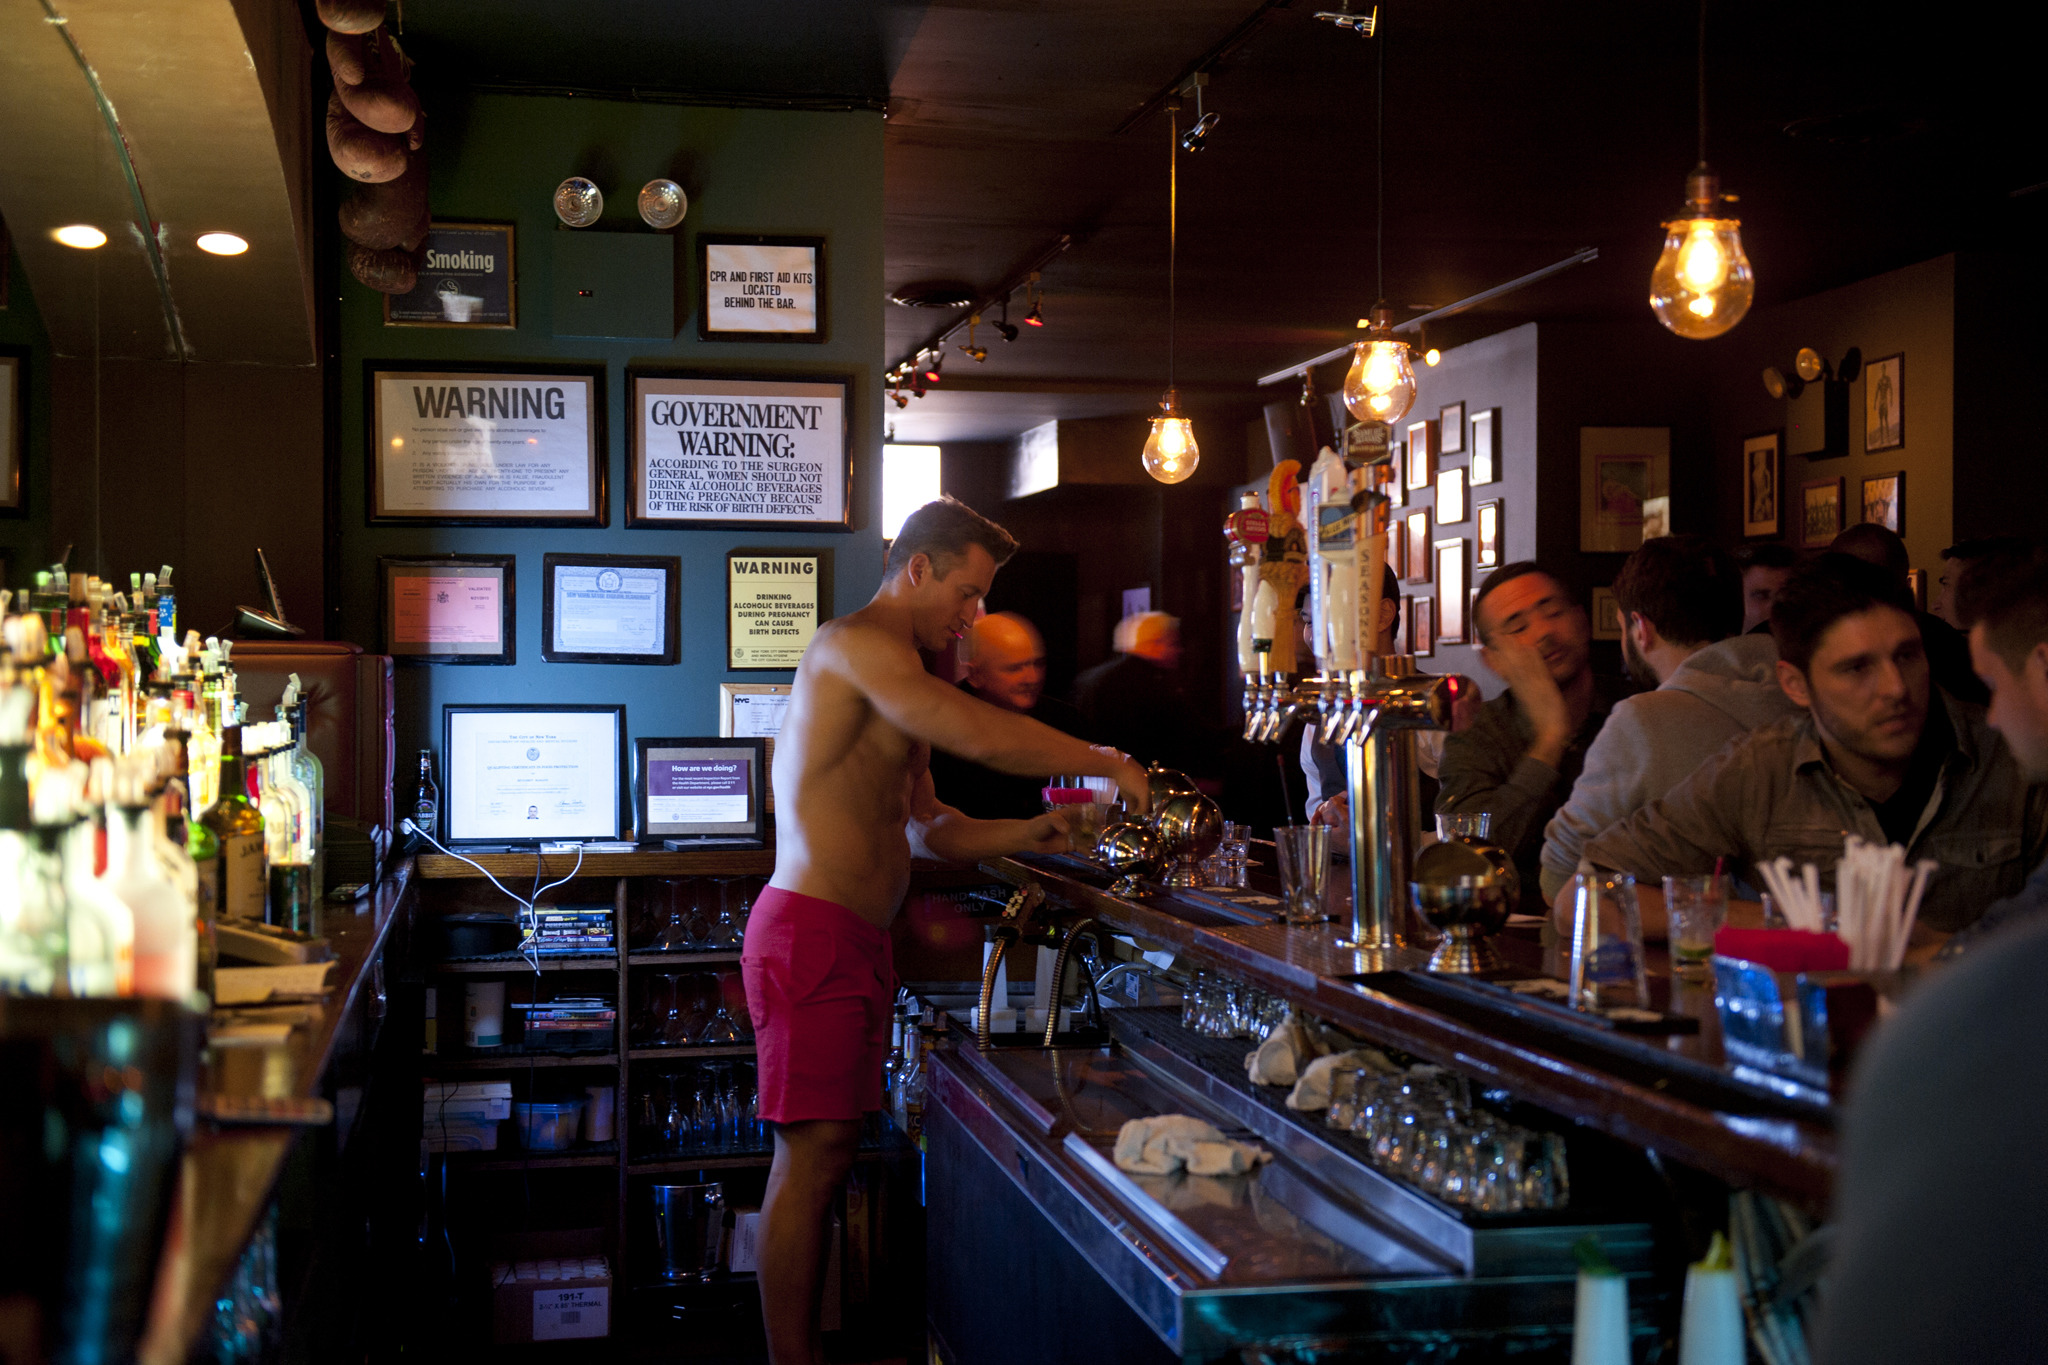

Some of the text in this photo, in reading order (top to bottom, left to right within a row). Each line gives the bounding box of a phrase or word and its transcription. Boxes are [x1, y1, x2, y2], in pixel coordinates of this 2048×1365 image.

[426, 249, 495, 273] Smoking
[710, 270, 813, 284] CPR AND FIRST AID KITS
[742, 284, 781, 296] LOCATED
[724, 296, 797, 309] BEHIND THE BAR.
[413, 386, 565, 419] WARNING
[651, 400, 823, 430] GOVERNMENT
[678, 431, 795, 459] WARNING:
[649, 458, 823, 472] ACCORDING TO THE SURGEON
[649, 469, 823, 483] GENERAL, WOMEN SHOULD NOT
[649, 479, 823, 493] DRINK ALCOHOLIC BEVERAGES
[649, 490, 823, 504] DURING PREGNANCY BECAUSE
[648, 501, 815, 515] OF THE RISK OF BIRTH DEFECTS.
[734, 561, 814, 575] WARNING
[713, 764, 737, 773] doing?
[932, 889, 1006, 903] HAND WASH
[954, 902, 986, 913] ONLY
[558, 1292, 584, 1301] 191-T
